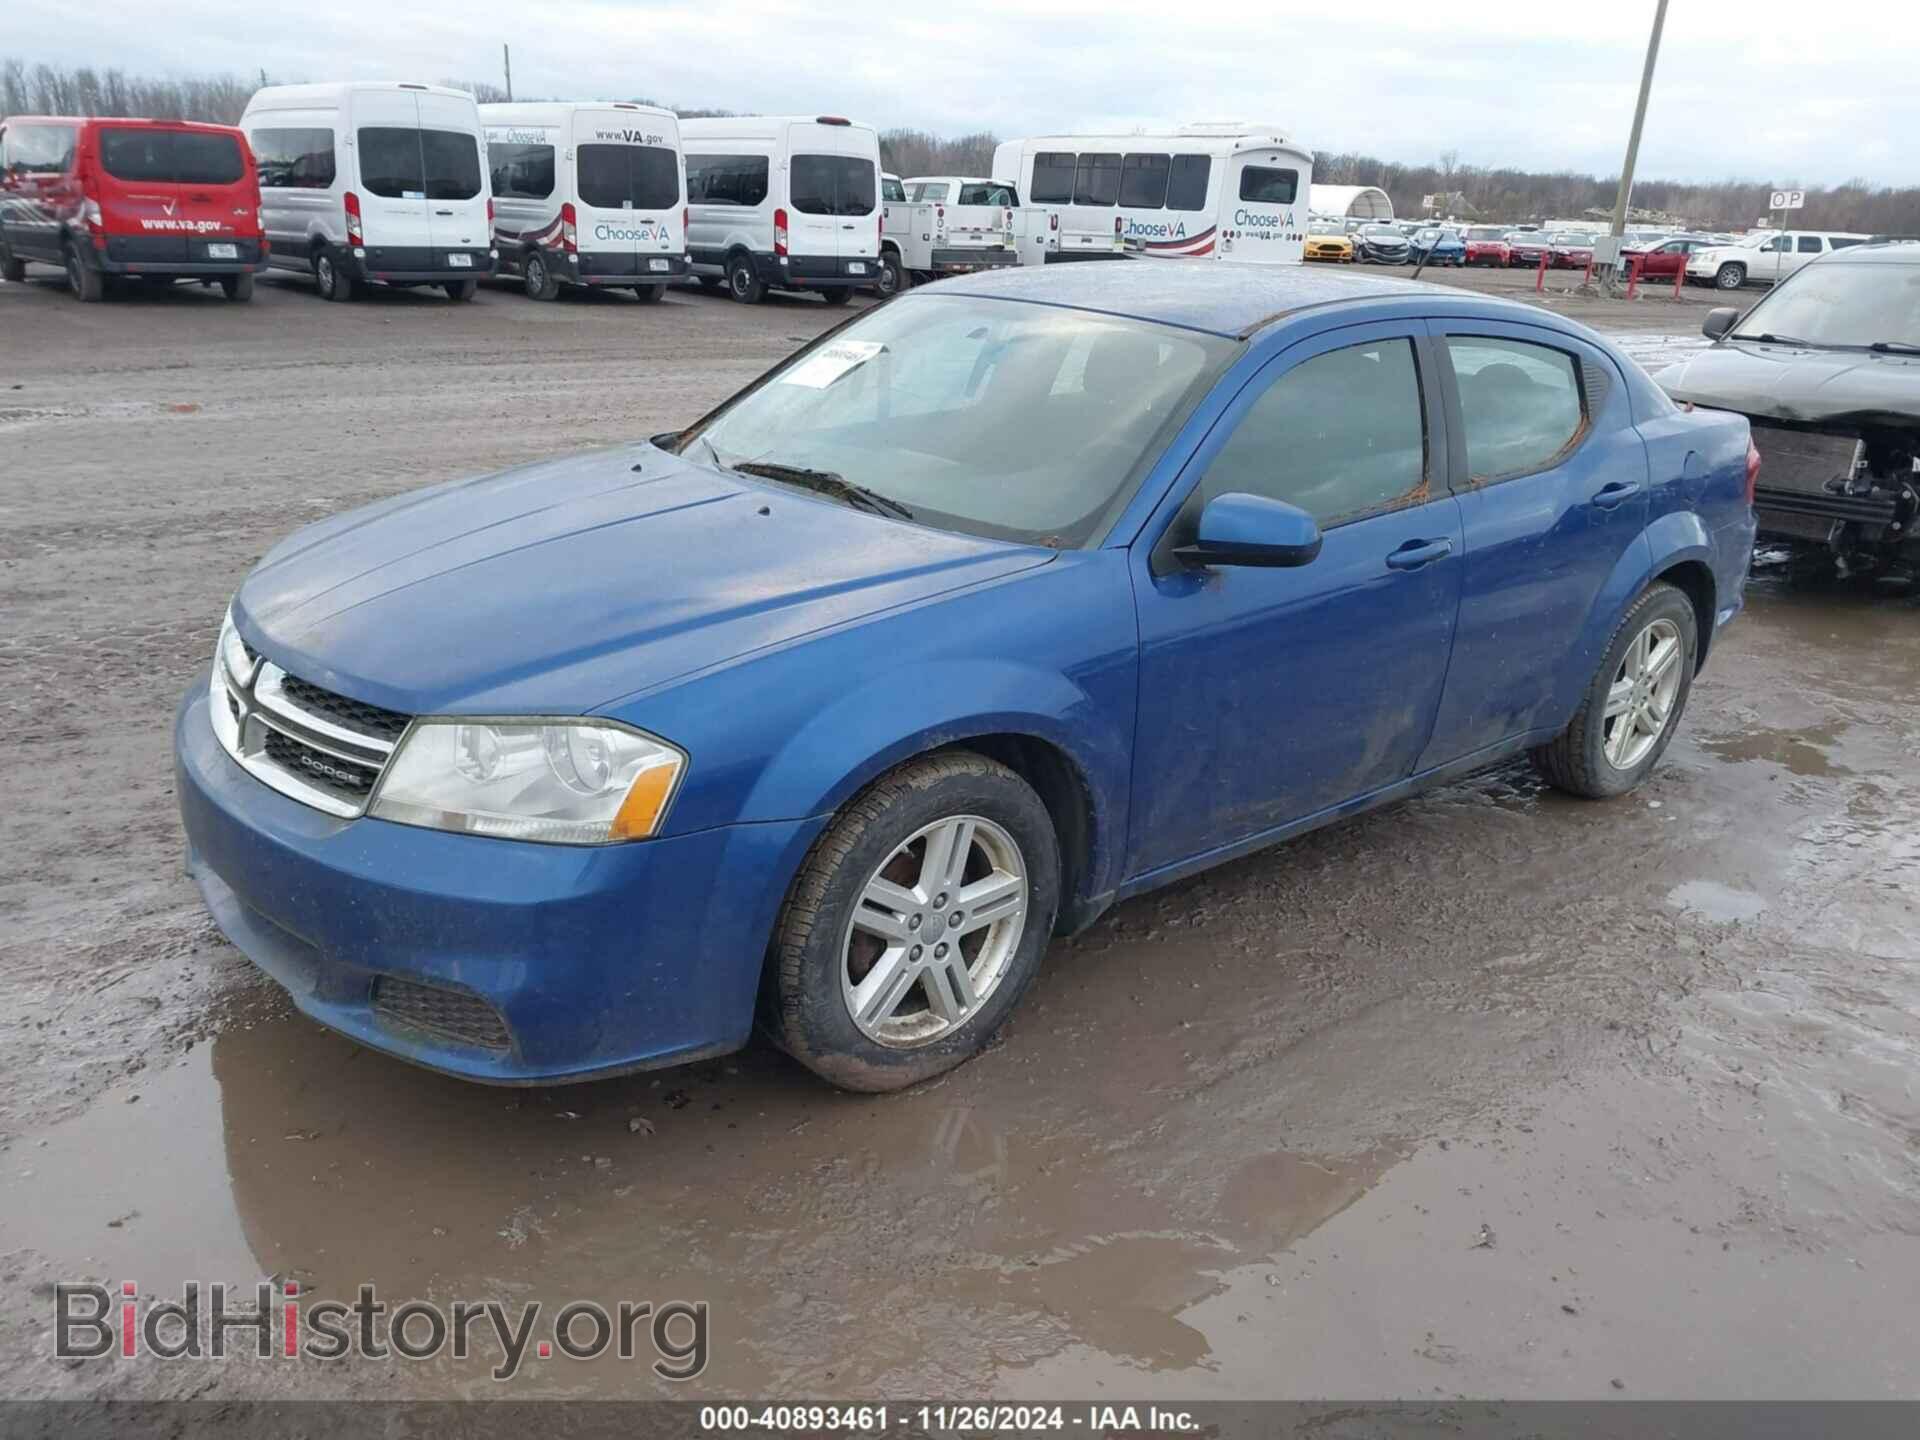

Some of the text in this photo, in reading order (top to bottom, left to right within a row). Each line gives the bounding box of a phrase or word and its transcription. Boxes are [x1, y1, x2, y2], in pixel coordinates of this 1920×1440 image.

[595, 129, 664, 145] www.VA.gov
[1234, 207, 1295, 228] ChooseVA
[141, 219, 221, 233] www.va.gov
[594, 225, 670, 240] ChooseVA
[301, 755, 361, 785] DODGE
